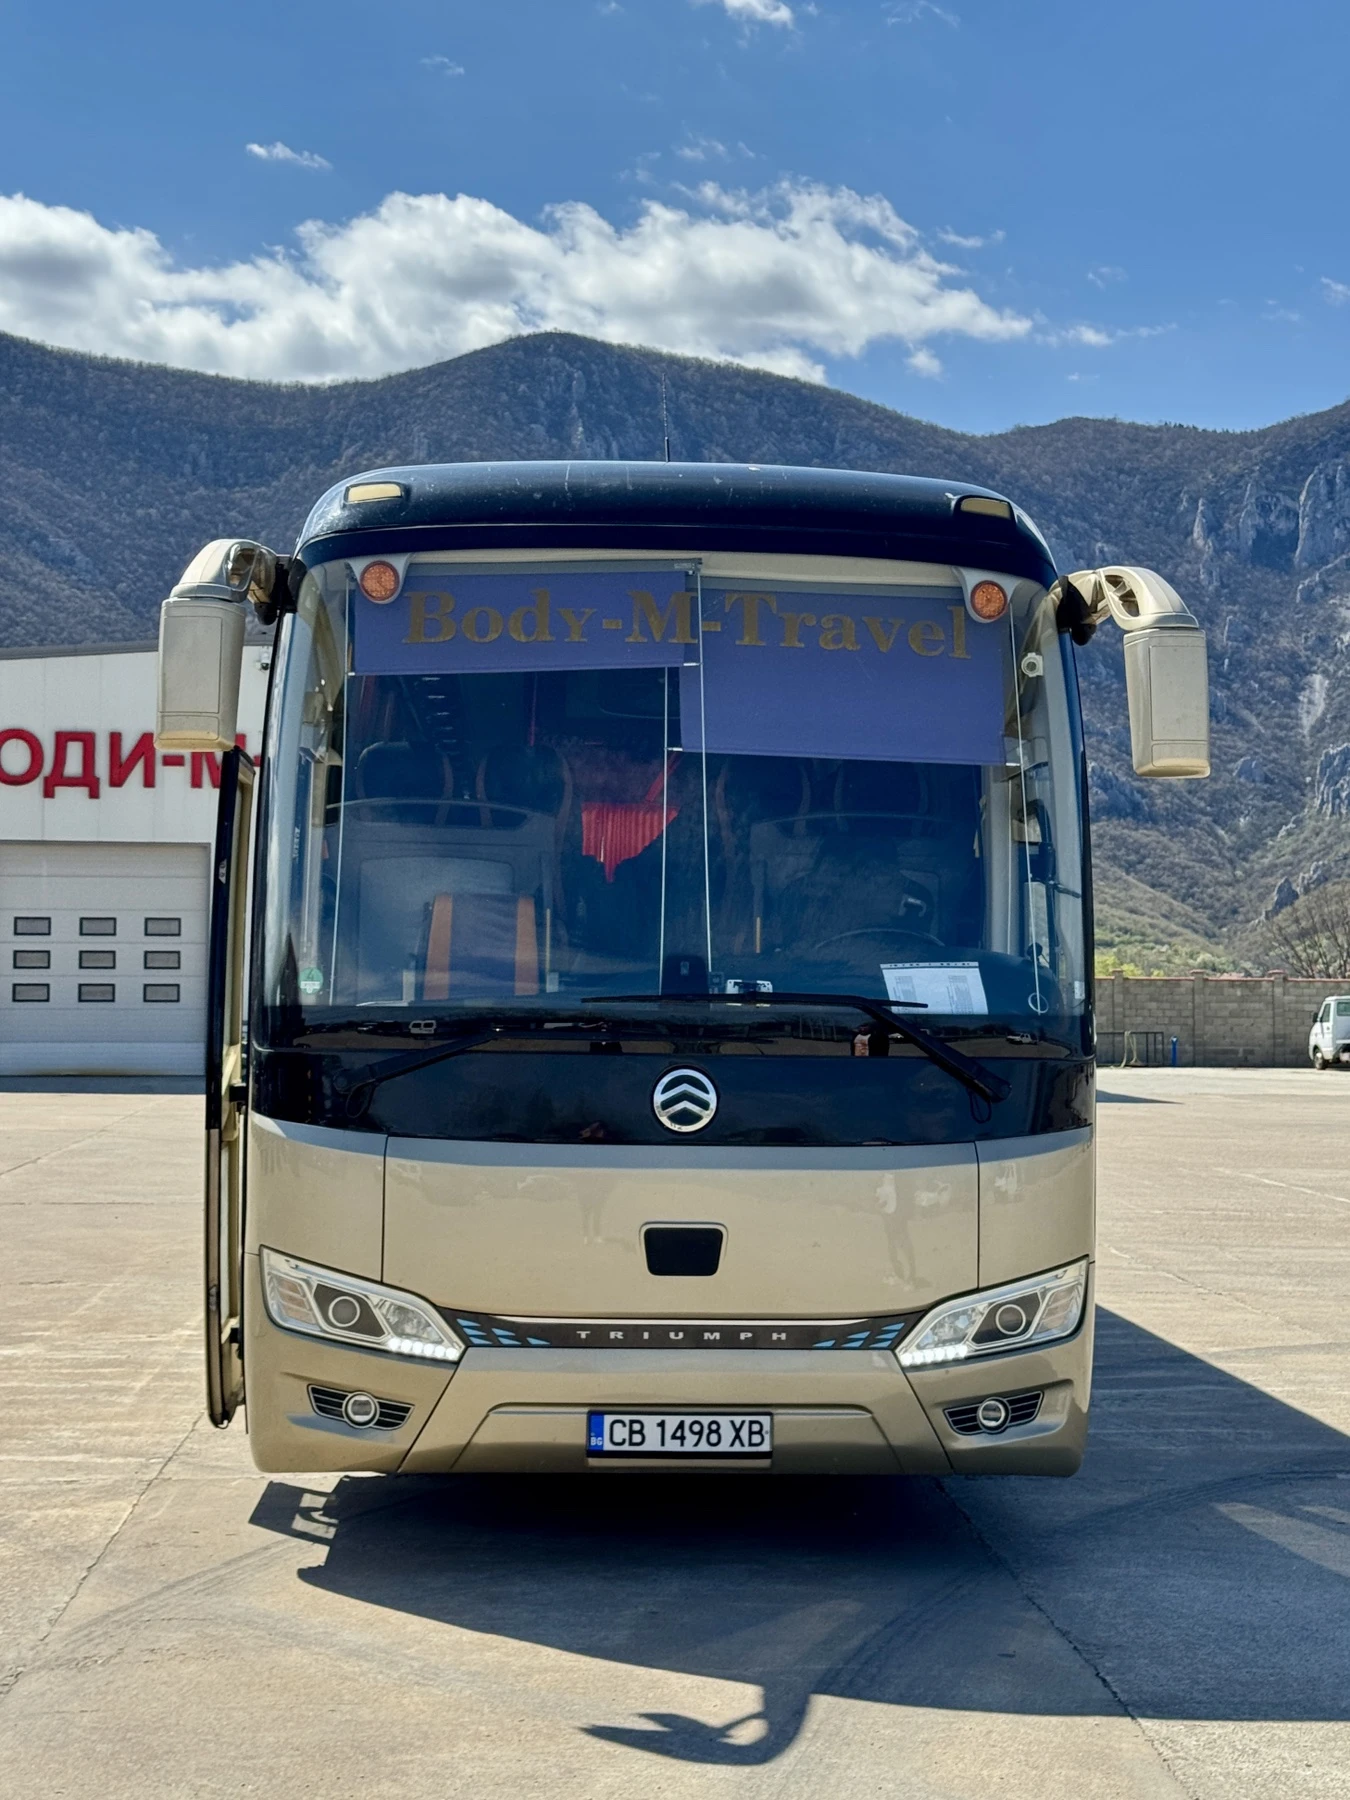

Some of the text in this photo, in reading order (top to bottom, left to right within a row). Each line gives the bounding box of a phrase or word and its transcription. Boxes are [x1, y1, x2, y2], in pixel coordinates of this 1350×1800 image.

[576, 1330, 787, 1341] TRIUMPH
[609, 1418, 765, 1448] CB 1498 XB
[590, 1436, 603, 1446] BG
